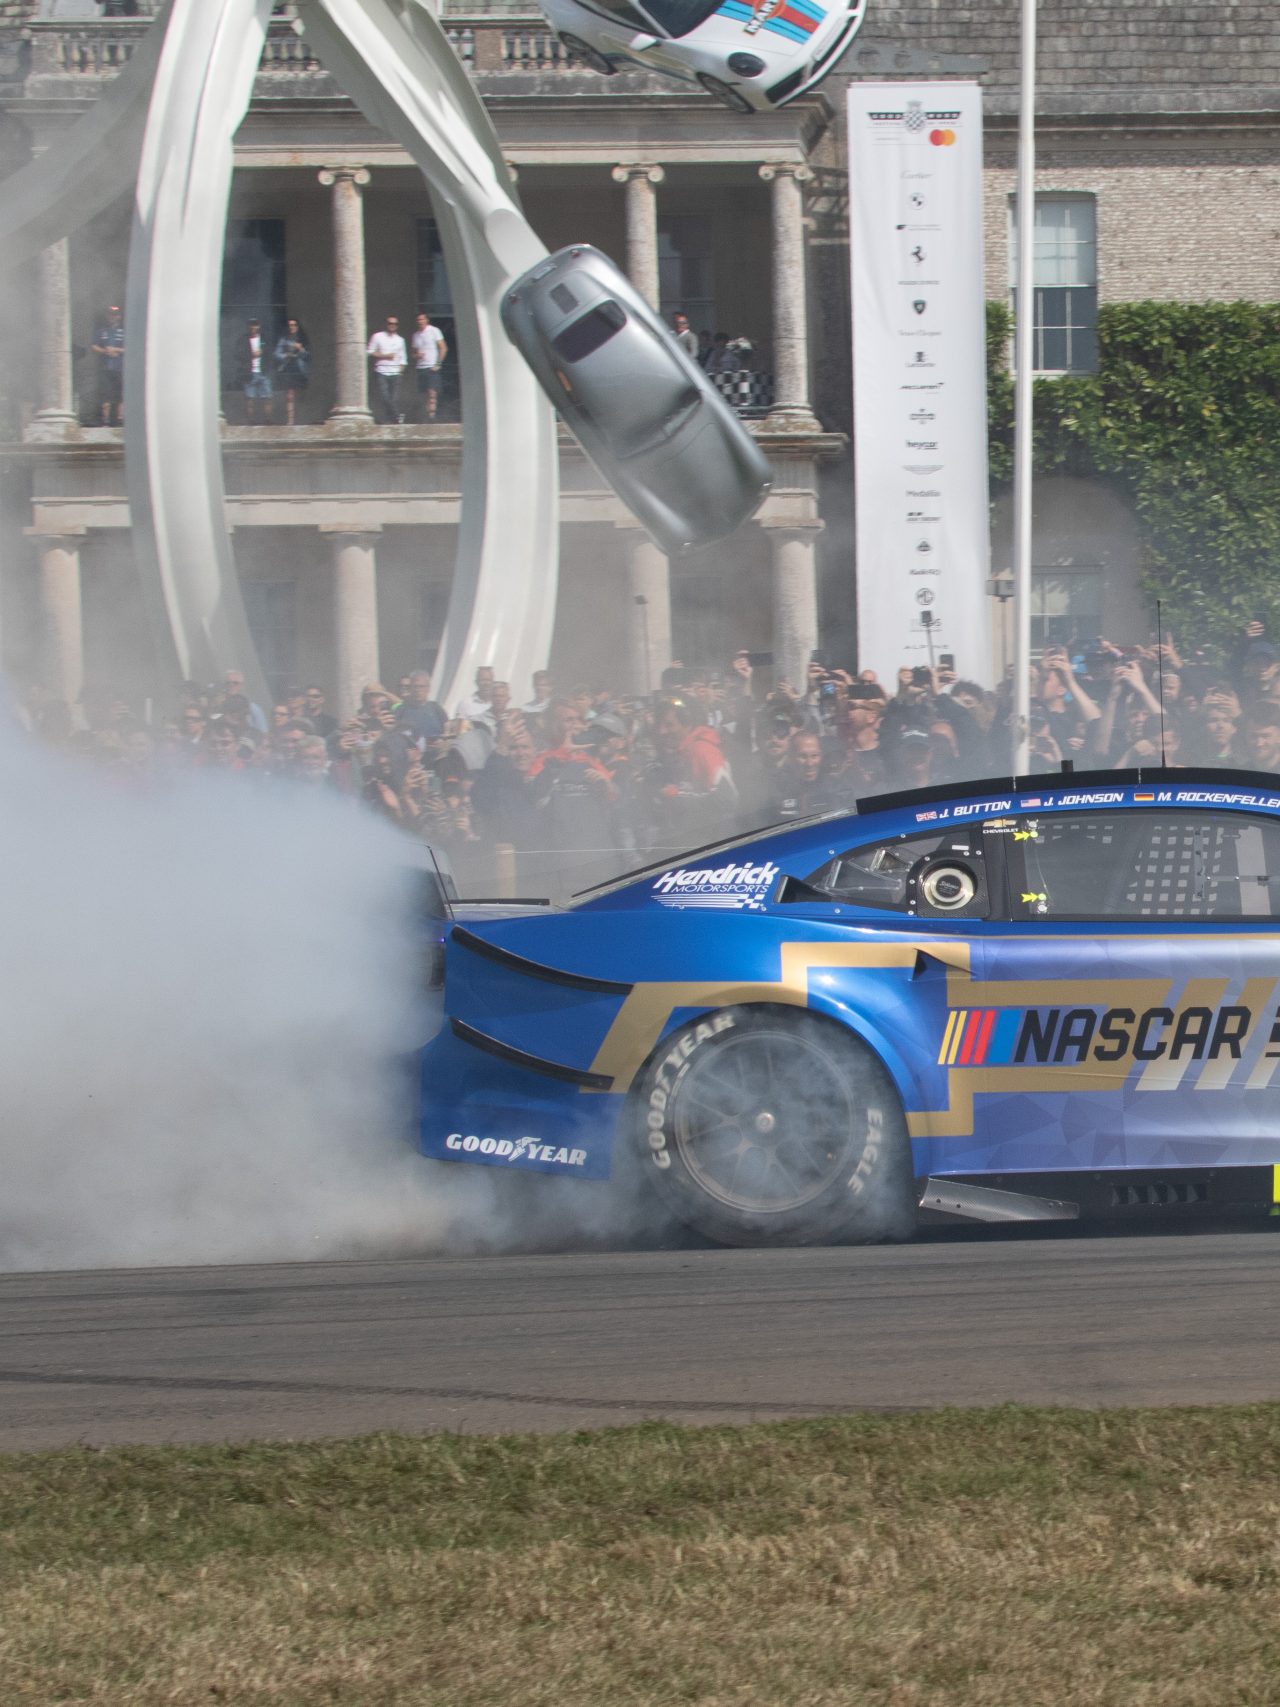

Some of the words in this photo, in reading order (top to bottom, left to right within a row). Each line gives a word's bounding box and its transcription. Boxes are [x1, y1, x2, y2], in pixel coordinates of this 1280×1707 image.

[939, 808, 949, 819] J.
[954, 801, 1011, 816] BUTTON
[1044, 797, 1053, 807] J.
[1058, 793, 1124, 806] JOHNSON
[1157, 792, 1171, 802] M.
[652, 862, 780, 893] Hendrick
[671, 884, 769, 893] MOTORSPORTS
[1014, 1005, 1253, 1063] NASCAR
[648, 1014, 736, 1169] GOODYEAR
[446, 1133, 587, 1165] GOODYEAR
[847, 1107, 883, 1196] EAGLE
